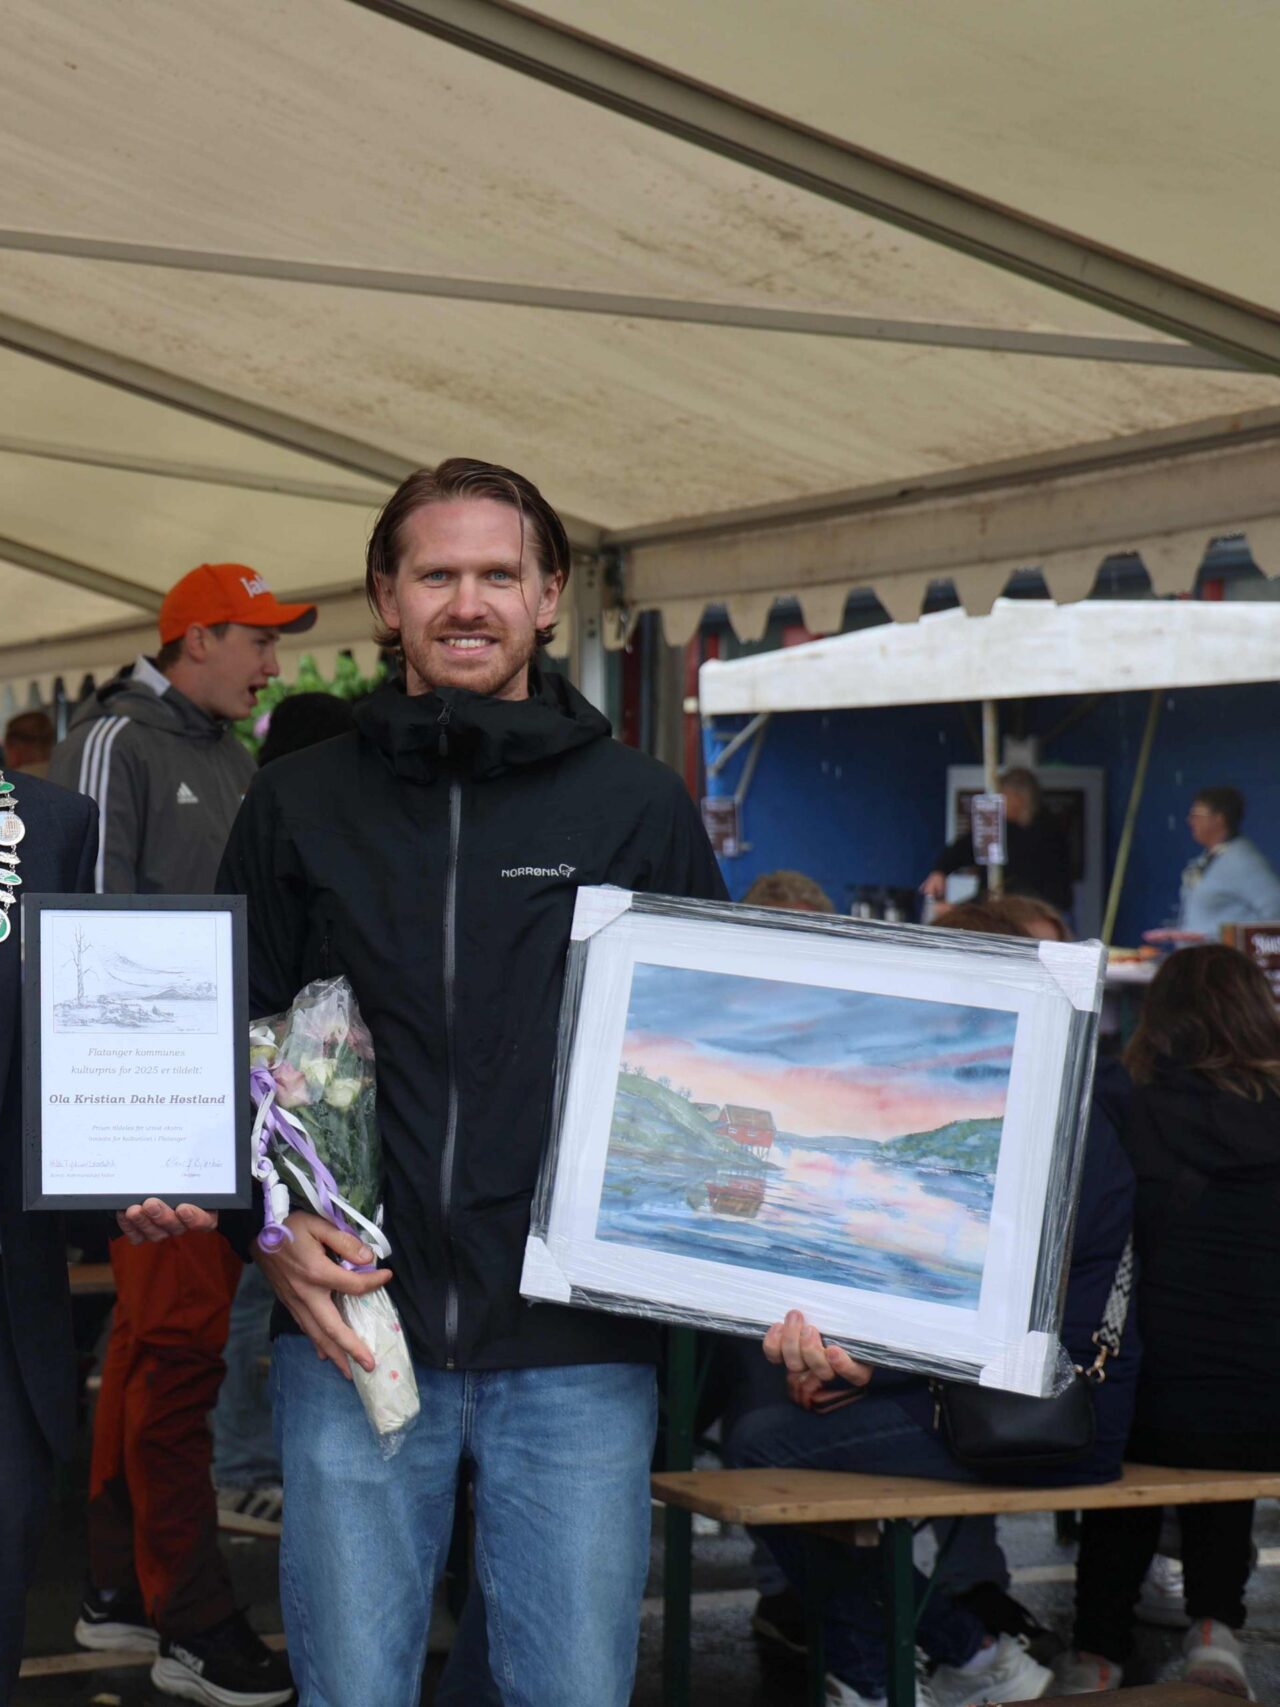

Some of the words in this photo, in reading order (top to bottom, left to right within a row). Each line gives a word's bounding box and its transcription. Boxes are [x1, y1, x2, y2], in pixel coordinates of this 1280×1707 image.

[501, 866, 559, 878] NORRØNA
[88, 1048, 133, 1058] Flatanger
[135, 1048, 186, 1057] kommunes
[71, 1065, 116, 1076] kulturpris
[118, 1065, 132, 1076] for
[134, 1066, 159, 1075] 2025
[161, 1067, 171, 1075] er
[49, 1094, 70, 1104] Ola
[73, 1094, 126, 1104] Kristian
[130, 1094, 166, 1104] Dahle
[169, 1094, 226, 1104] Høstland
